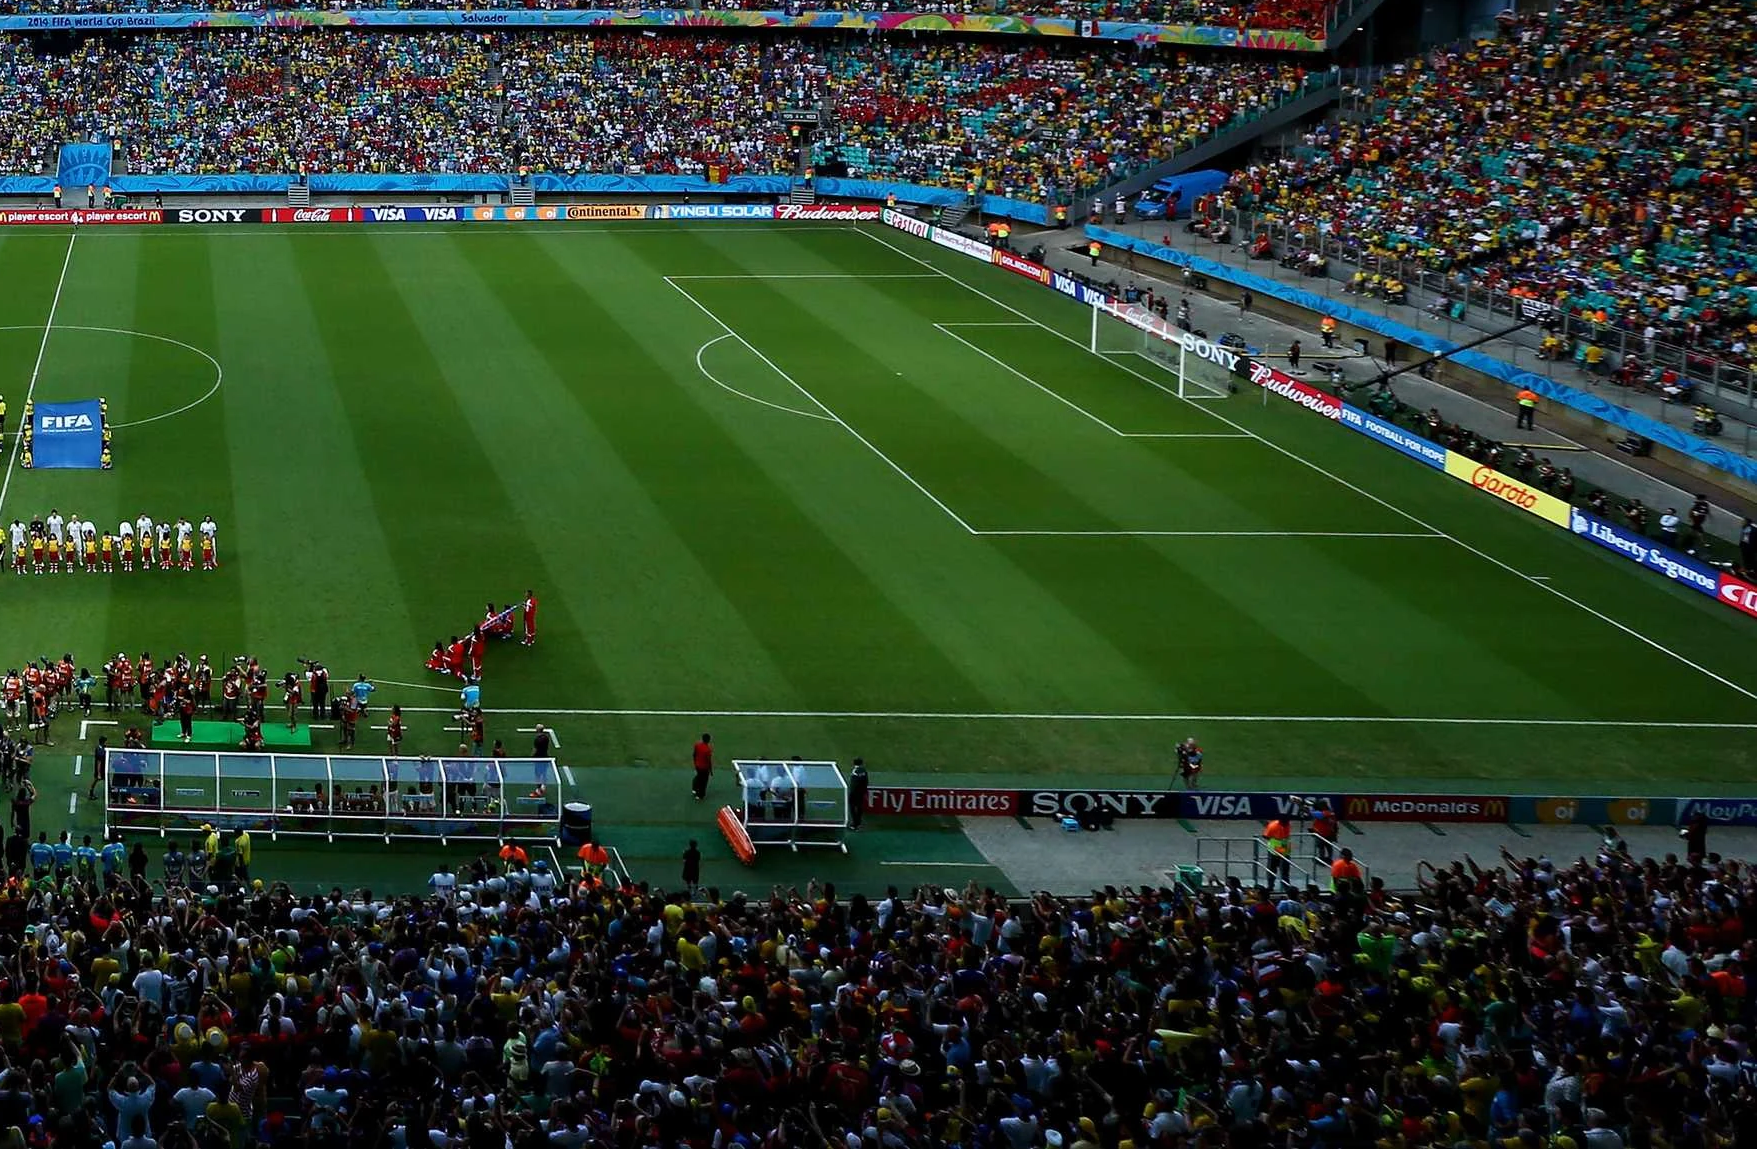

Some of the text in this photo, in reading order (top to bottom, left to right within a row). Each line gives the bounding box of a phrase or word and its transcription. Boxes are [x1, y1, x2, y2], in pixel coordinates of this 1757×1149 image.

[52, 17, 71, 26] FIFA
[74, 17, 103, 27] World
[106, 17, 123, 28] Cup
[127, 16, 156, 26] Brazil
[461, 13, 509, 23] Salvador
[8, 212, 69, 222] player escort
[86, 212, 115, 222] player
[179, 210, 246, 223] SONY
[371, 208, 406, 221] VISA
[422, 207, 457, 220] VISA
[567, 206, 631, 218] Continental
[670, 206, 773, 216] YINGLI SOLAR
[776, 204, 880, 220] Budweiser
[891, 213, 927, 238] Castrol
[1053, 273, 1076, 297] VISA
[1082, 286, 1106, 308] VISA
[1183, 332, 1241, 372] SONY
[1249, 360, 1341, 420] Budweiser
[41, 413, 93, 429] FIFA
[1342, 409, 1445, 464] FIFA FOOTBALL FOR HOPE
[1471, 465, 1538, 509] Garoto
[1591, 520, 1716, 590] Liberty Seguros
[866, 790, 1011, 812] Fly Emirates
[1032, 792, 1166, 816] SONY
[1191, 796, 1252, 816] VISA
[1373, 800, 1481, 815] McDonald's
[1554, 801, 1575, 819] oi
[1627, 801, 1647, 820] oi
